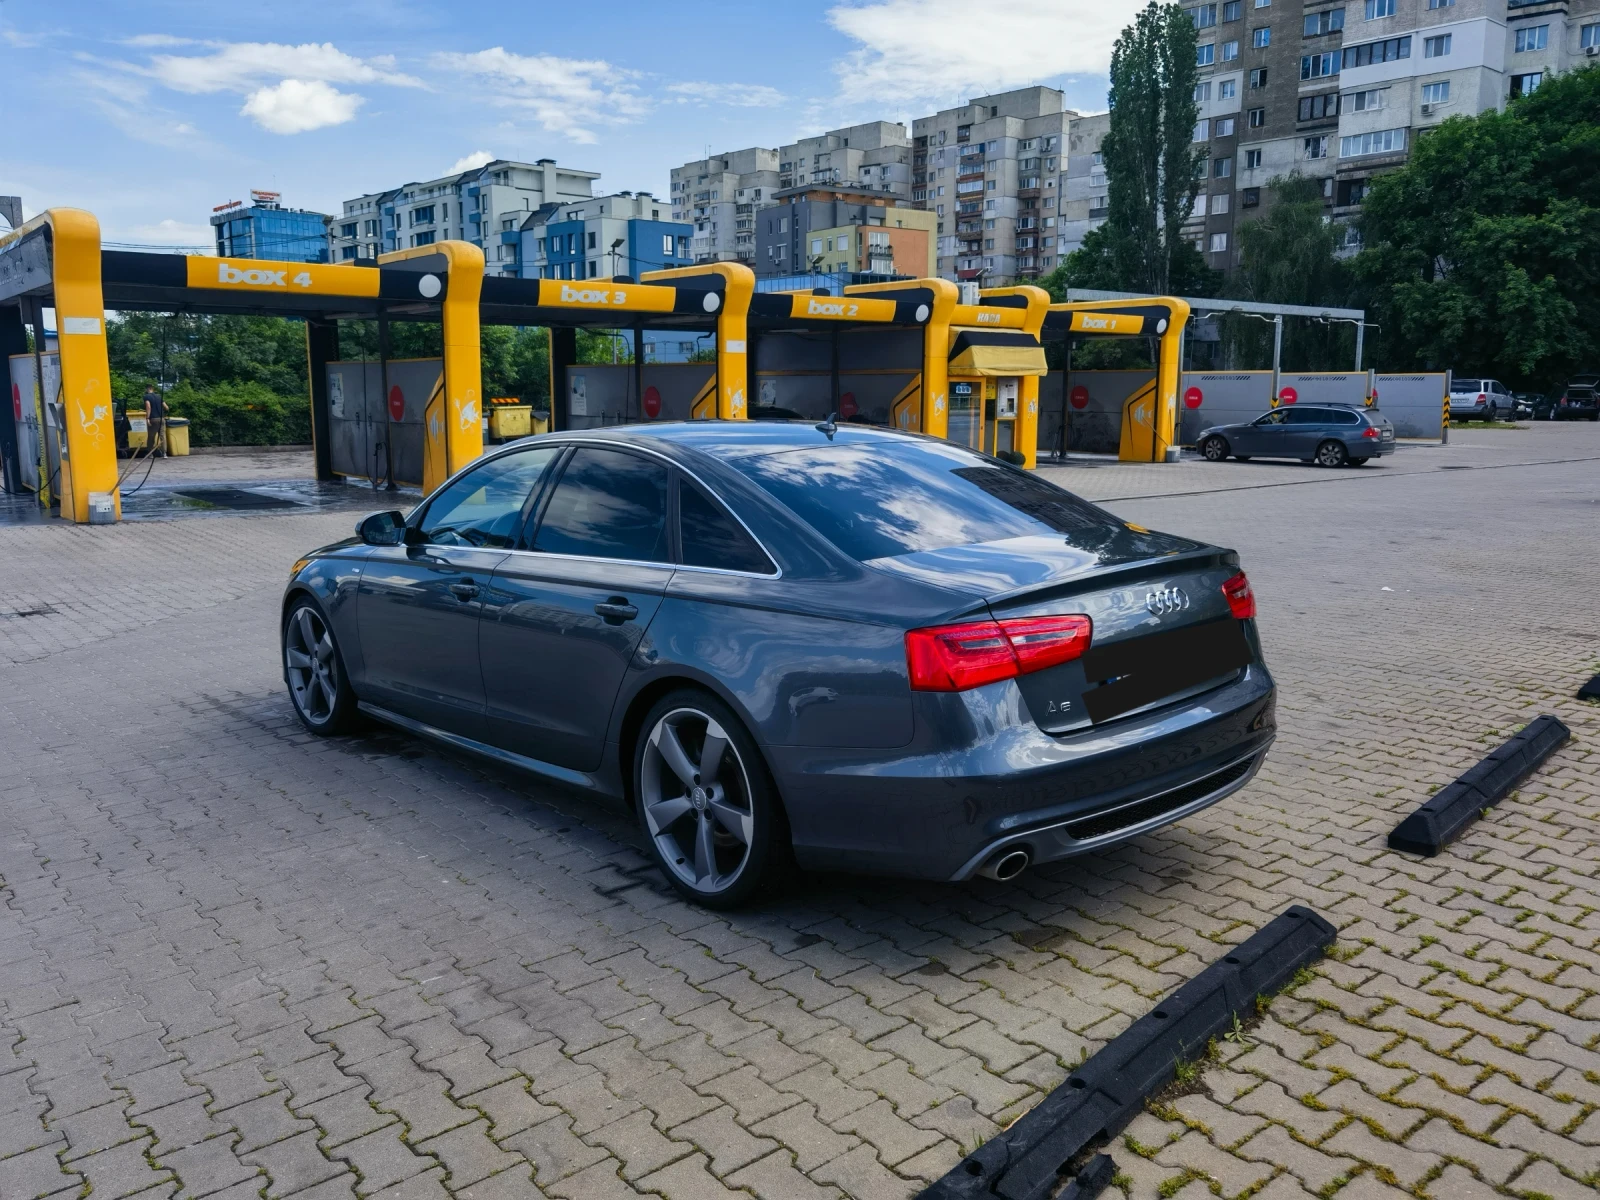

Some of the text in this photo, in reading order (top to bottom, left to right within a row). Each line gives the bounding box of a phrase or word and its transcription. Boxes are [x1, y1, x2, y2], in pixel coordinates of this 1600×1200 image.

[218, 263, 313, 288] box 4
[560, 285, 627, 305] box 3
[808, 299, 859, 317] box 2
[1081, 315, 1117, 330] box 1
